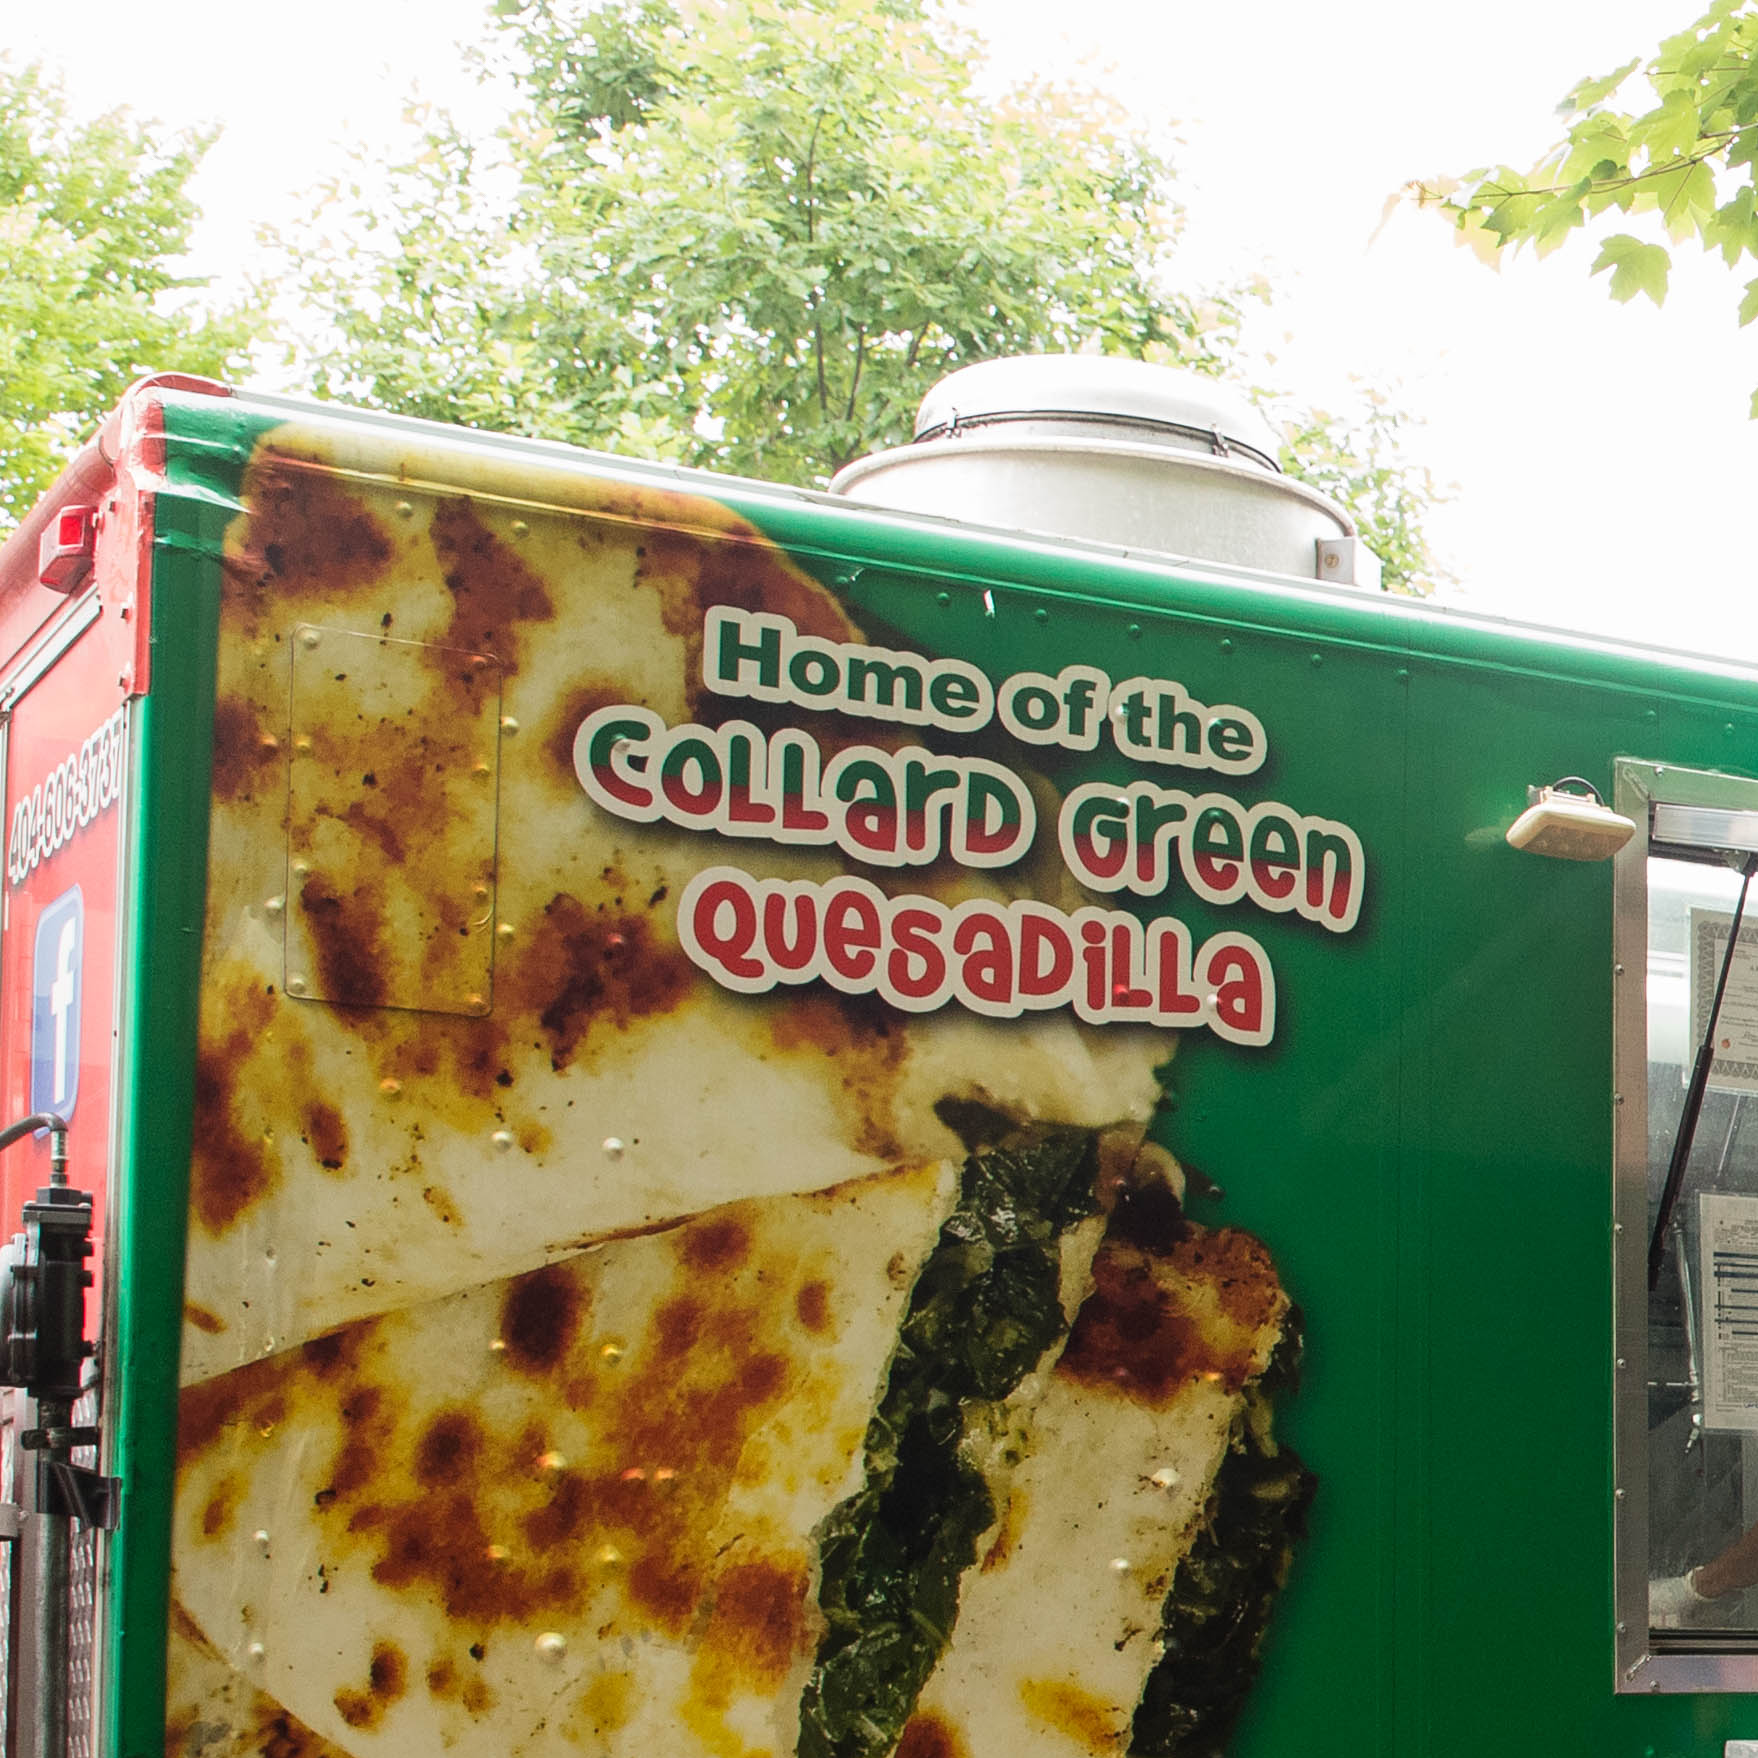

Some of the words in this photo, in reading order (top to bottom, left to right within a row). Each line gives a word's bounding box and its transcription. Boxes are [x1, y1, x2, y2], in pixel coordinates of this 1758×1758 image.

[713, 618, 983, 722] Home
[1010, 678, 1102, 740] of
[1124, 691, 1256, 767] the
